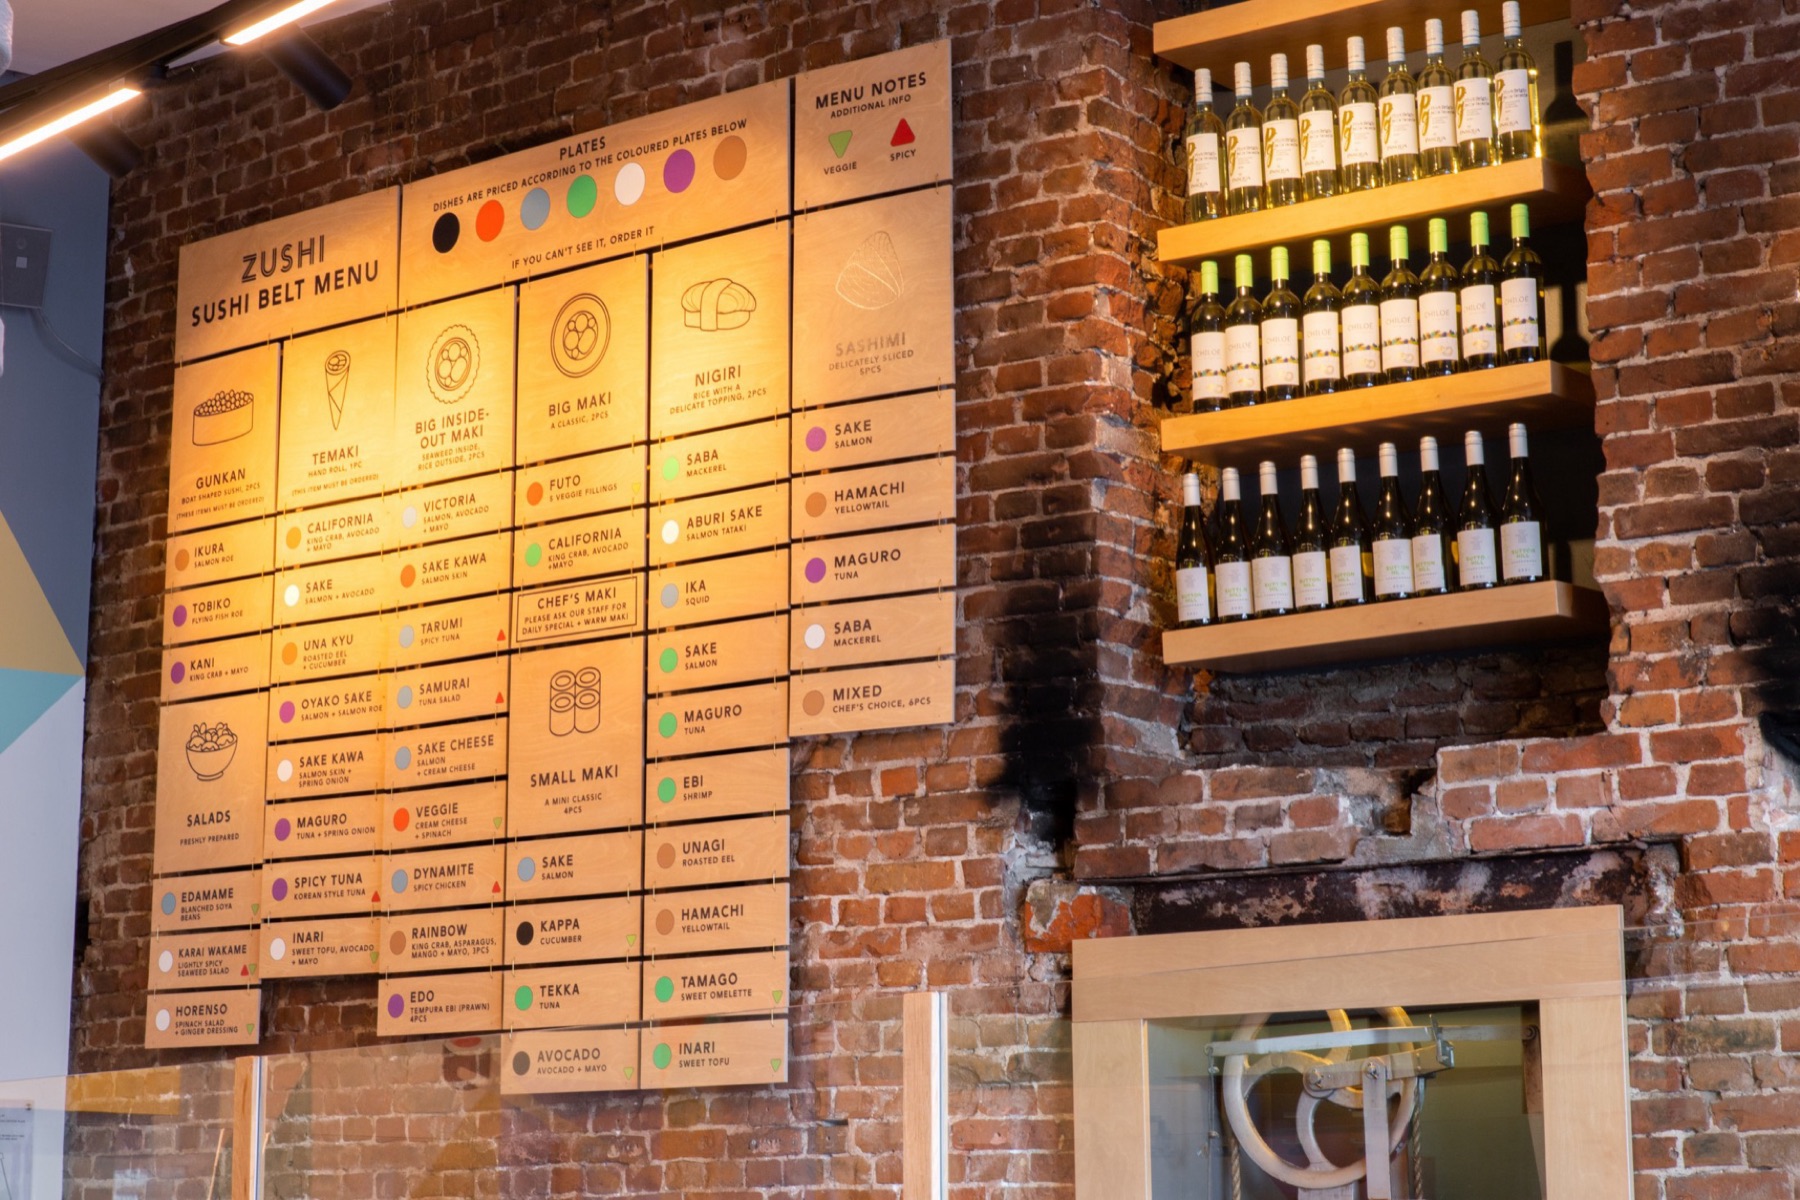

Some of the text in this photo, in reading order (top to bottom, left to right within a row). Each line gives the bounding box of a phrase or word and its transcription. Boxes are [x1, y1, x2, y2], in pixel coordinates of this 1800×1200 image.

[816, 72, 926, 108] MENU NOTES
[830, 94, 911, 118] ADDITIONAL INFO
[560, 136, 606, 159] PLATES
[890, 149, 916, 161] SPICY
[433, 119, 747, 211] DISHES ARE PRICED ACCORDING TO THE COLOURED PLATES BELOW
[824, 162, 857, 174] VEGGIE
[512, 259, 519, 268] IF
[523, 254, 542, 265] YOU
[545, 246, 573, 260] CAN'T
[576, 241, 592, 253] SEE
[610, 229, 642, 244] ORDER
[646, 226, 654, 235] IT
[242, 234, 325, 284] ZUSHI
[192, 260, 378, 326] SUSHI BELT MENU
[836, 332, 906, 356] SASHIMI
[695, 365, 741, 386] NIGIRI
[549, 393, 611, 416] BIG MAKI
[415, 408, 489, 433] BIG INSIDE-
[835, 419, 871, 435] SAKE
[420, 425, 483, 448] OUT MAKI
[835, 436, 872, 448] SALMON
[312, 446, 358, 464] TEMAKI
[687, 449, 719, 465] SABA
[686, 464, 726, 476] MACKEREL
[196, 469, 245, 488] GUNKAN
[550, 474, 580, 490] FUTO
[835, 482, 904, 501] HAMACHI
[424, 493, 476, 512] VICTORIA
[835, 500, 889, 513] YELLOWTAIL
[307, 513, 373, 533] CALIFORNIA
[687, 505, 762, 528] ABURI SAKE
[548, 528, 621, 549] CALIFORNIA
[686, 525, 746, 540] SALMON TATAKI
[194, 542, 224, 557] IKURA
[422, 552, 486, 573] SAKE KAWA
[834, 549, 901, 567] MAGURO
[834, 570, 859, 580] TUNA
[306, 579, 332, 592] SAKE
[686, 580, 706, 593] IKA
[192, 598, 231, 613] TOBIKO
[537, 587, 616, 609] CHEF'S MAKI
[685, 595, 710, 605] SQUID
[524, 614, 550, 623] PLEASE
[569, 608, 585, 617] OUR
[587, 605, 608, 614] STAFF
[612, 602, 626, 610] FOR
[421, 618, 462, 633] TARUMI
[522, 626, 542, 634] DAILY
[545, 621, 574, 631] SPECIAL
[584, 616, 607, 625] WARM
[834, 619, 872, 634] SABA
[304, 634, 353, 650] UNA KYU
[834, 635, 881, 646] MACKEREL
[685, 642, 716, 657] SAKE
[190, 658, 214, 670] KANI
[685, 659, 717, 669] SALMON
[420, 678, 470, 694] SAMURAI
[833, 685, 882, 700] MIXED
[301, 690, 372, 709] OYAKO SAKE
[832, 703, 864, 712] CHEF'S
[908, 697, 931, 706] 6PCS
[684, 704, 742, 722] MAGURO
[684, 726, 705, 734] TUNA
[418, 734, 494, 755] SAKE CHEESE
[300, 751, 364, 767] SAKE KAWA
[530, 765, 618, 787] SMALL MAKI
[684, 775, 703, 788] EBI
[572, 792, 602, 802] CLASSIC
[683, 790, 712, 800] SHRIMP
[416, 802, 458, 817] VEGGIE
[187, 810, 231, 826] SALADS
[297, 813, 347, 828] MAGURO
[208, 833, 239, 842] PREPARED
[683, 839, 724, 854] UNAGI
[542, 854, 573, 868] SAKE
[682, 855, 735, 866] ROASTED EEL
[414, 863, 474, 879] DYNAMITE
[542, 871, 573, 880] SALMON
[294, 873, 362, 888] SPICY TUNA
[413, 880, 466, 891] SPICY CHICKEN
[181, 888, 233, 902] EDAMAME
[324, 890, 344, 898] STYLE
[181, 904, 214, 913] BLANCHED
[682, 904, 743, 920] HAMACHI
[412, 924, 467, 938] RAINBOW
[540, 918, 580, 932] KAPPA
[682, 922, 730, 932] YELLOWTAIL
[293, 931, 323, 943] INARI
[540, 935, 582, 944] CUCUMBER
[178, 944, 247, 957] KARAI WAKAME
[178, 968, 207, 976] SEAWEED
[681, 973, 738, 987] TAMAGO
[410, 990, 434, 1003] EDO
[540, 983, 580, 996] TEKKA
[681, 988, 752, 1000] SWEET OMELETTE
[176, 1004, 228, 1016] HORENSO
[537, 1048, 600, 1062] AVOCADO
[679, 1041, 715, 1054] INARI
[679, 1057, 730, 1068] SWEET TOFU
